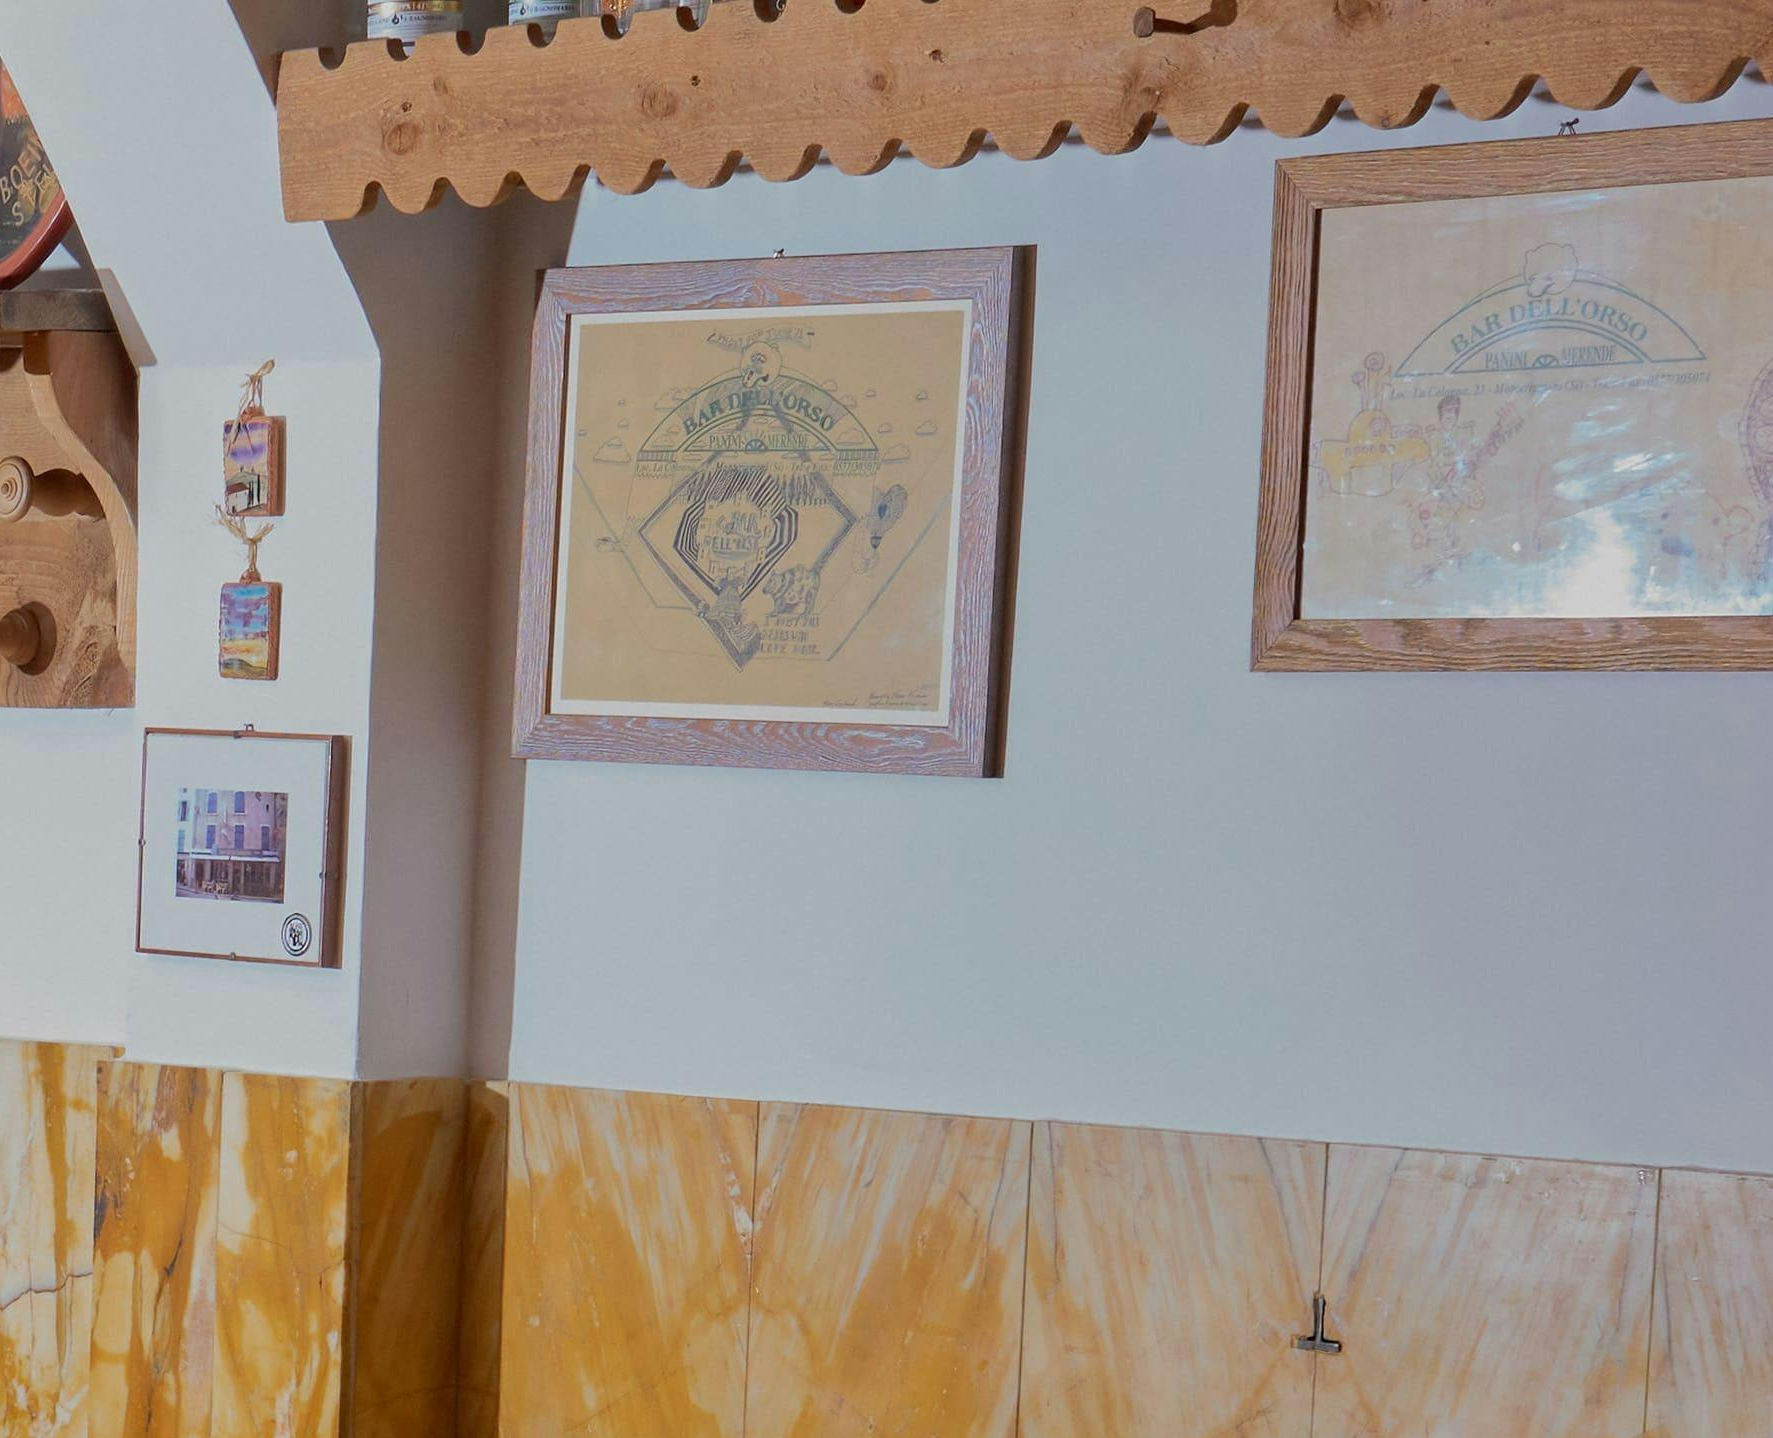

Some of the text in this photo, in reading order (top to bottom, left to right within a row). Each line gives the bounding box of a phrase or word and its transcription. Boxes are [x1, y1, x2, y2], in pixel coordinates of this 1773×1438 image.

[1450, 296, 1649, 355] BAR DELL'ORSO
[1484, 351, 1528, 369] PANINI
